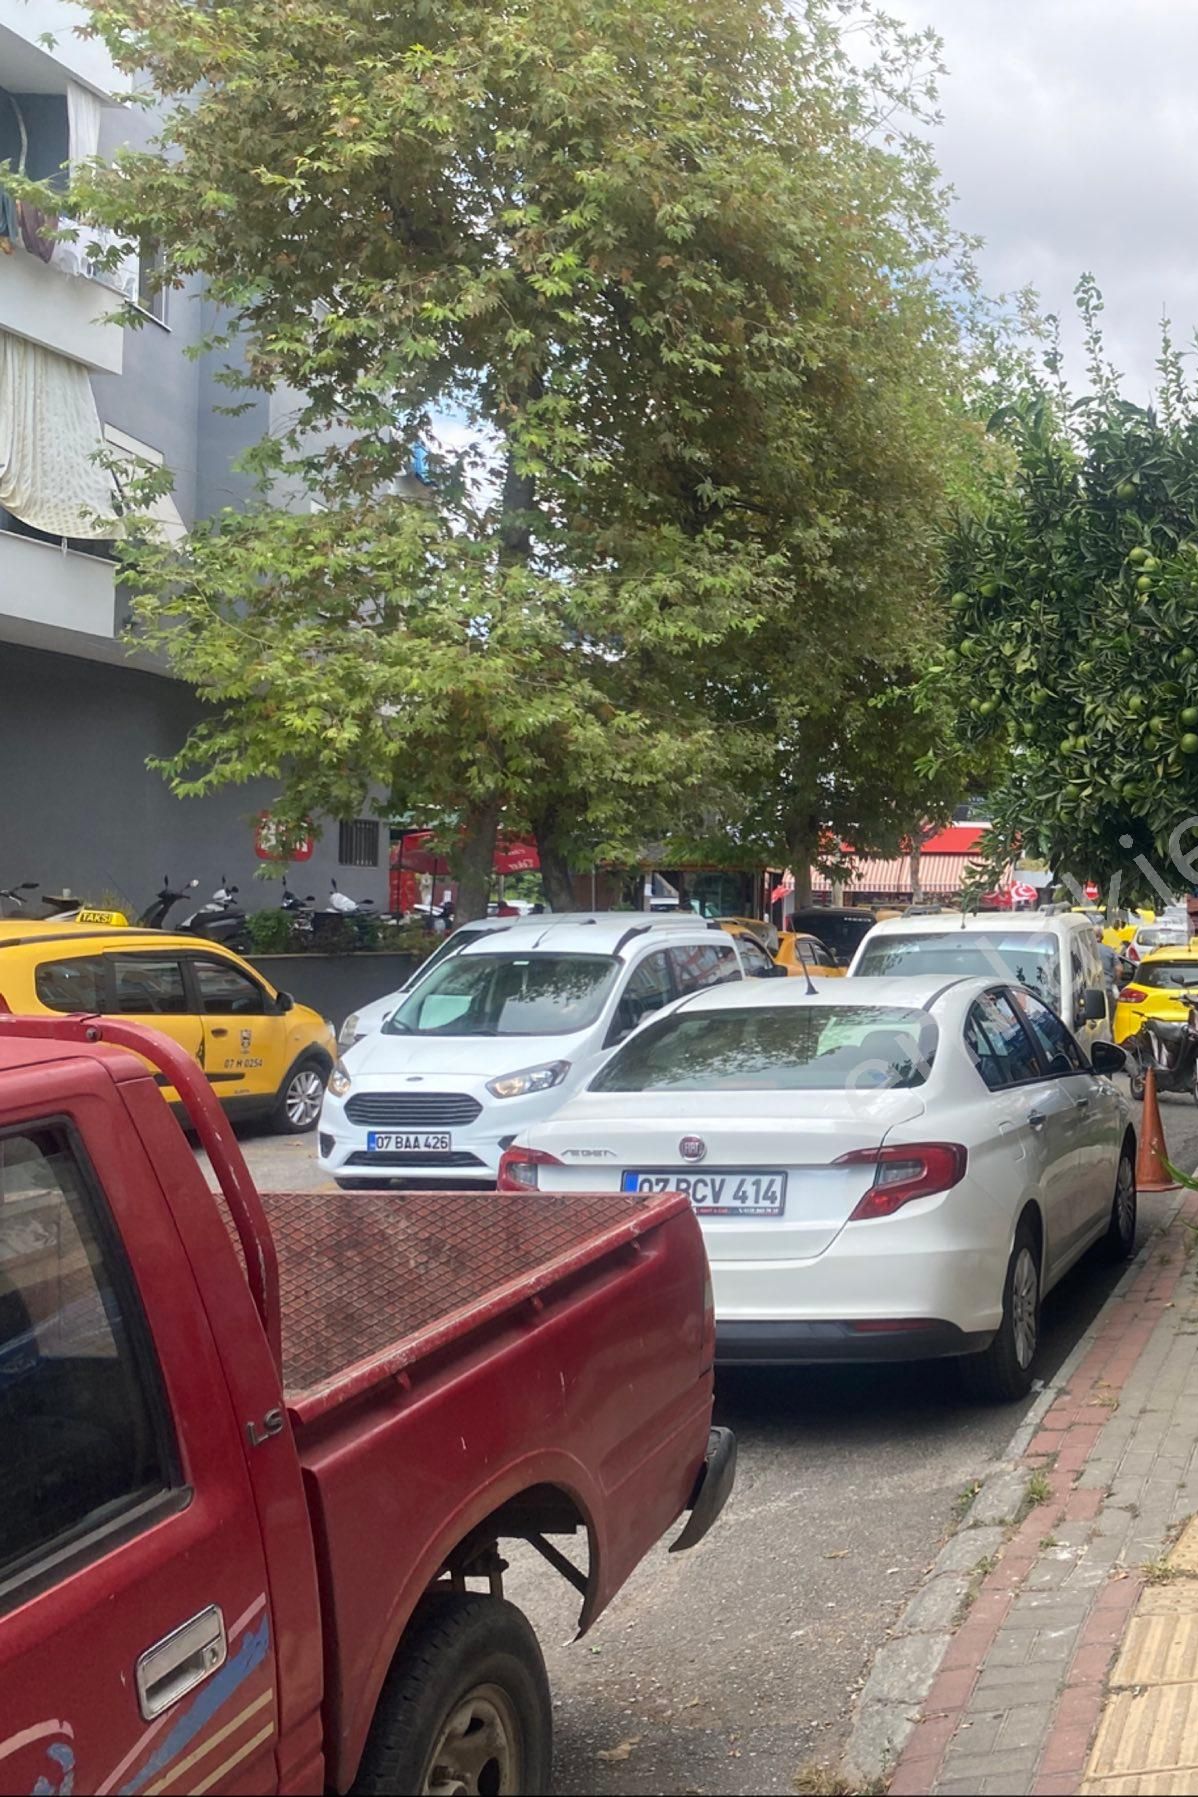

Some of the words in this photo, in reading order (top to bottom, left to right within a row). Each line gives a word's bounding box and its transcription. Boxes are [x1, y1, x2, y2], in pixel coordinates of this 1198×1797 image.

[224, 1059, 234, 1069] 07
[375, 1135, 392, 1149] 07
[395, 1136, 421, 1149] BAA
[423, 1136, 448, 1149] 426
[675, 1178, 726, 1204] BCV
[732, 1178, 778, 1204] 414
[247, 1407, 284, 1447] LS
